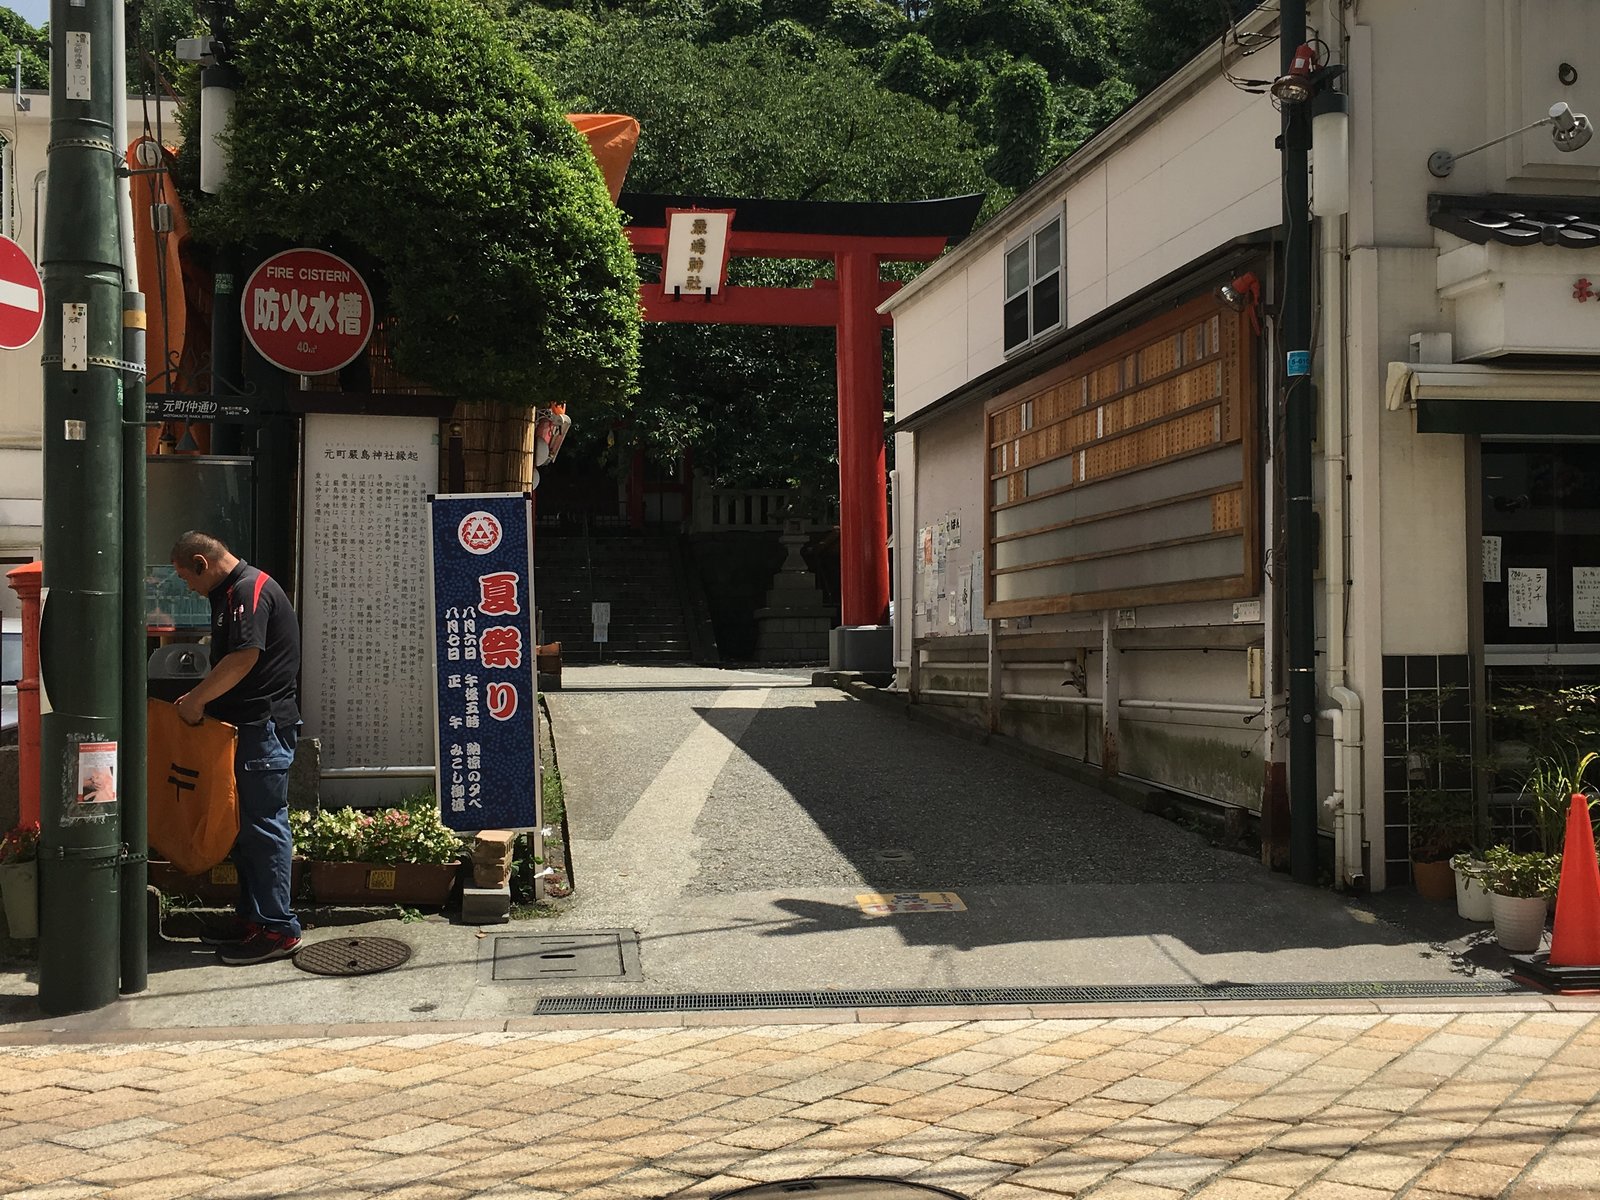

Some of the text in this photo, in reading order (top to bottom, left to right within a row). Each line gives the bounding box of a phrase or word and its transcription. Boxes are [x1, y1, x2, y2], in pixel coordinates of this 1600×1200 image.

[73, 75, 87, 86] 13
[266, 266, 350, 283] FIRE CISTERN
[68, 316, 81, 324] 元町
[253, 287, 363, 336] 防火水槽
[162, 400, 218, 414] 元町仲通り
[445, 606, 460, 661] 八月七日
[478, 571, 523, 722] 夏祭り
[462, 606, 482, 809] 八月六日 午後五時 納涼の夕べ
